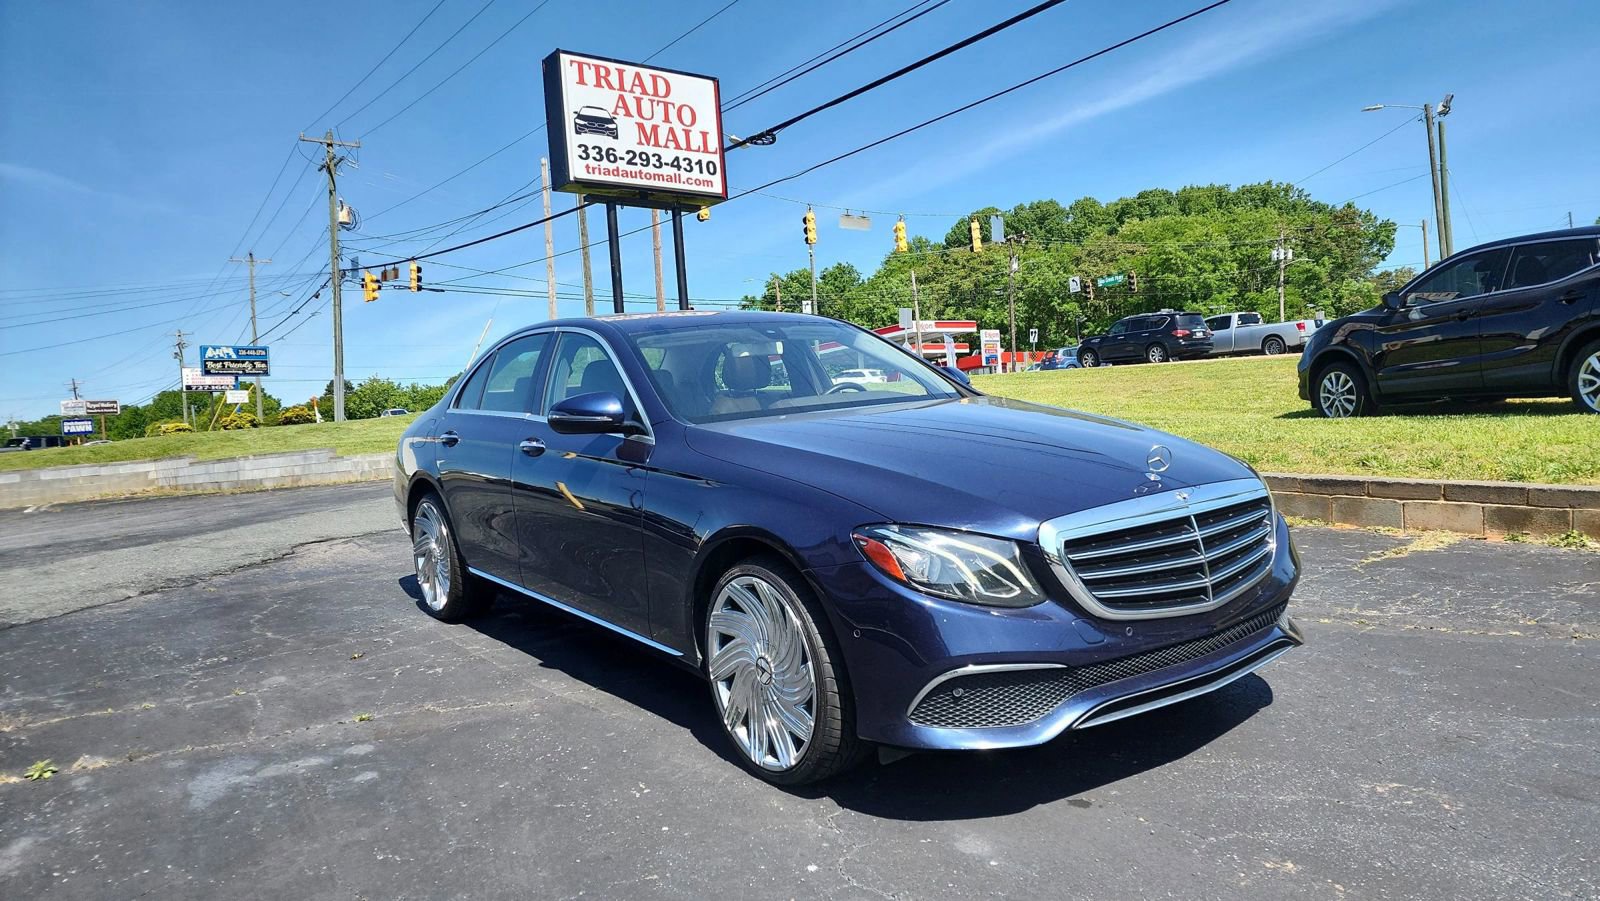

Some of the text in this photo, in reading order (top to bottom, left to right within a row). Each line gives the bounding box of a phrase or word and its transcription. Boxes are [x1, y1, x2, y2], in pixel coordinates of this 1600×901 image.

[570, 59, 671, 99] TRIAD
[611, 94, 697, 127] AUTO
[635, 121, 718, 155] MALL
[577, 143, 717, 176] 336-293-4310
[585, 163, 714, 188] triadautomall.com
[205, 361, 223, 369] Best
